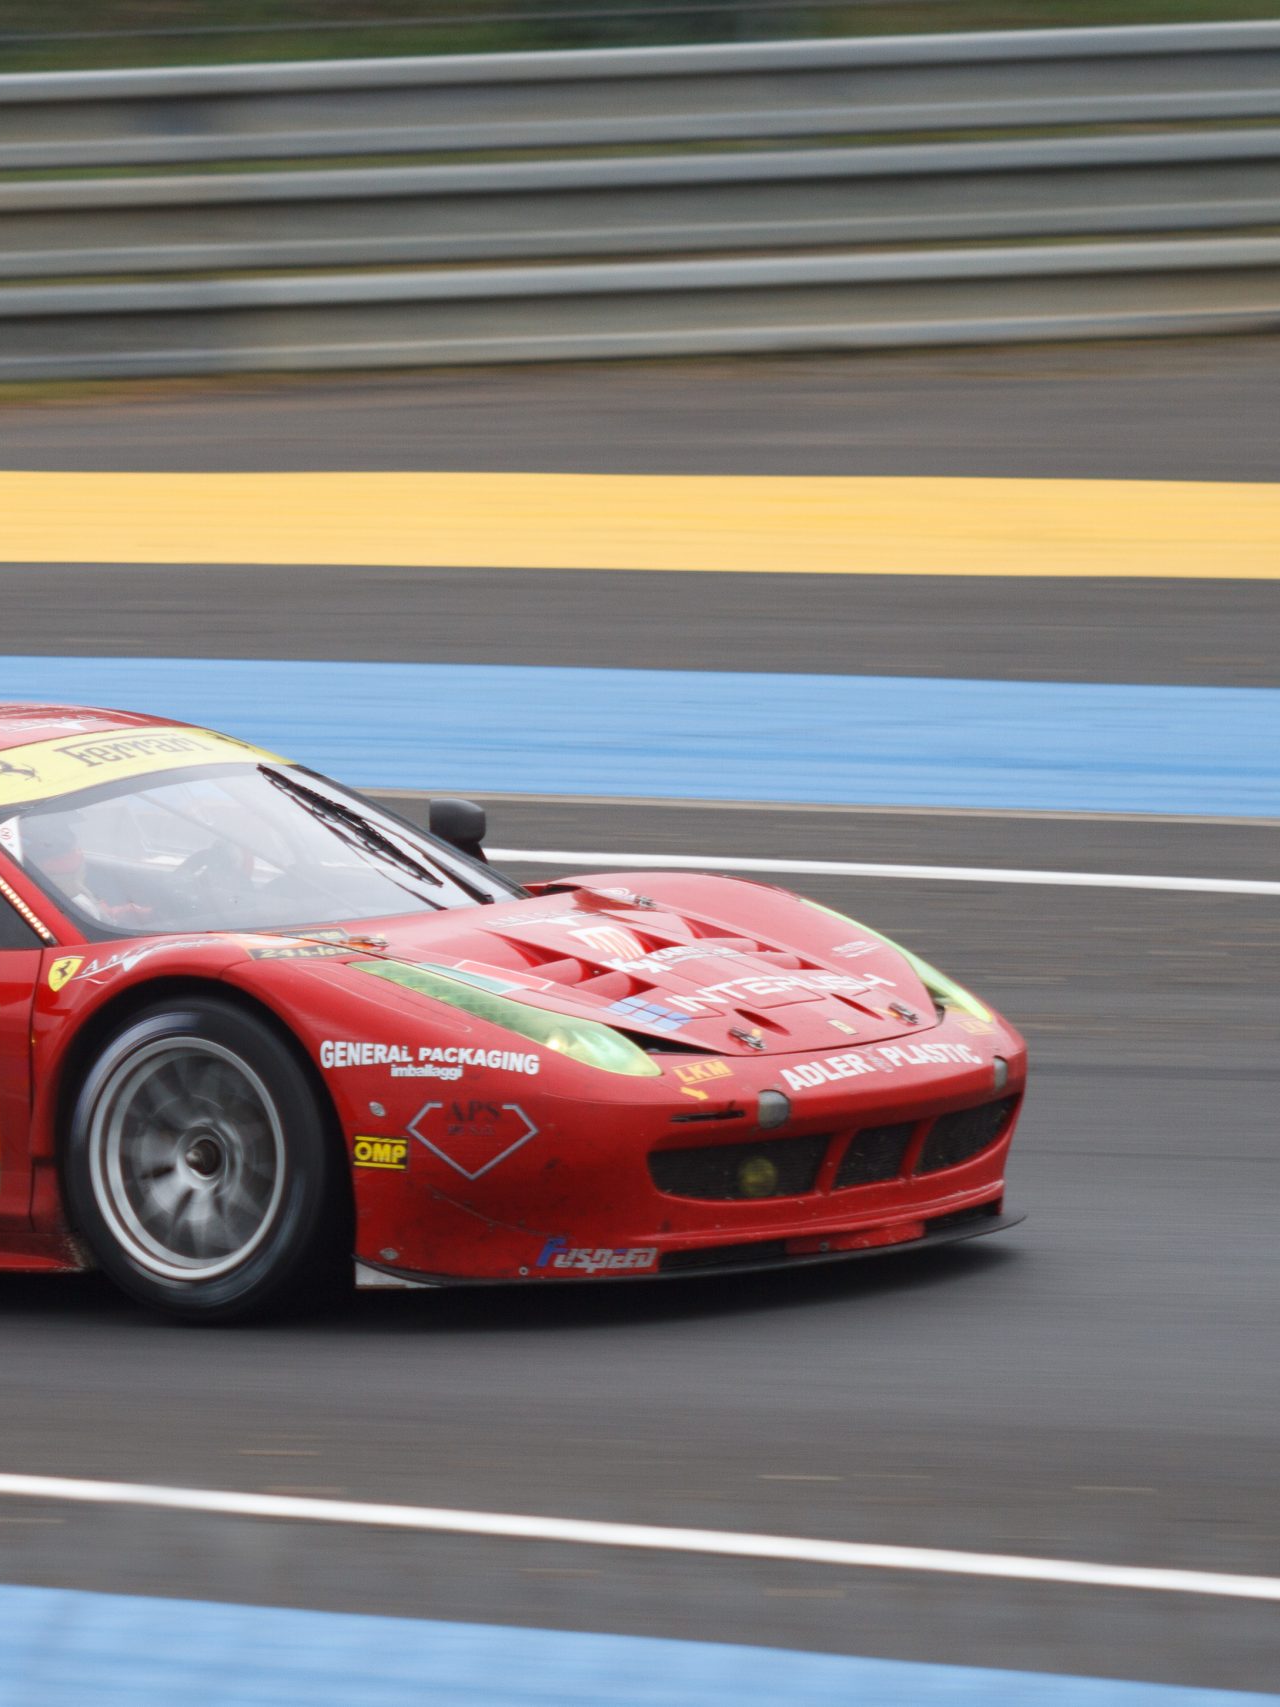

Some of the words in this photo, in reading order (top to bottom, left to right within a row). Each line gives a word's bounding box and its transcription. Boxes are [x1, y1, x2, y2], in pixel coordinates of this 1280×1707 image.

[54, 733, 214, 767] Ferrari
[665, 973, 895, 1012] INTERUSH
[320, 1040, 413, 1068] GENERAL
[418, 1047, 540, 1075] PACKAGING
[391, 1064, 463, 1080] imballaggi
[673, 1060, 732, 1082] LKM
[780, 1053, 873, 1091] ADLER
[876, 1044, 984, 1067] PLASTIC
[354, 1142, 407, 1164] OMP
